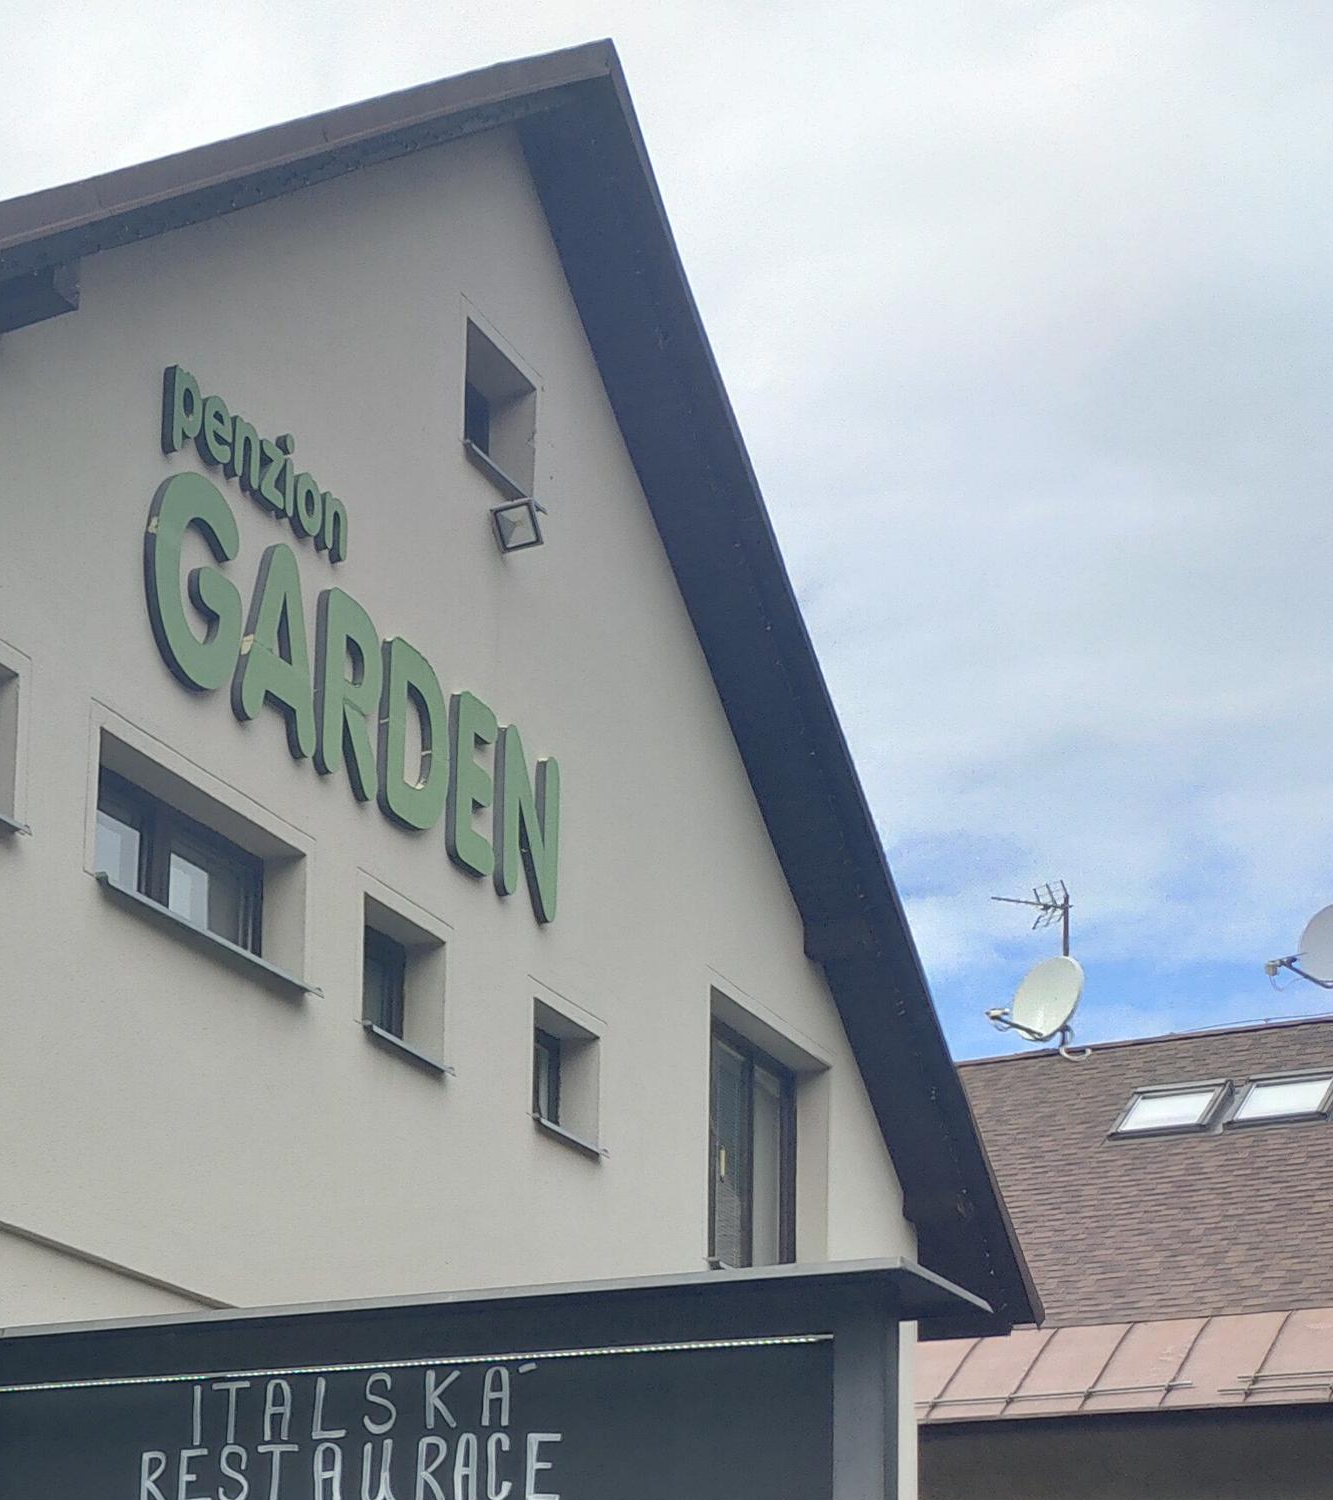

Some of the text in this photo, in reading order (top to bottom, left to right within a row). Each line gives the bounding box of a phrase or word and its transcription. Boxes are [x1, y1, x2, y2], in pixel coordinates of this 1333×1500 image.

[162, 365, 348, 563] penzion
[144, 472, 560, 924] GARDEN
[192, 1362, 537, 1444] ITALSKÁ
